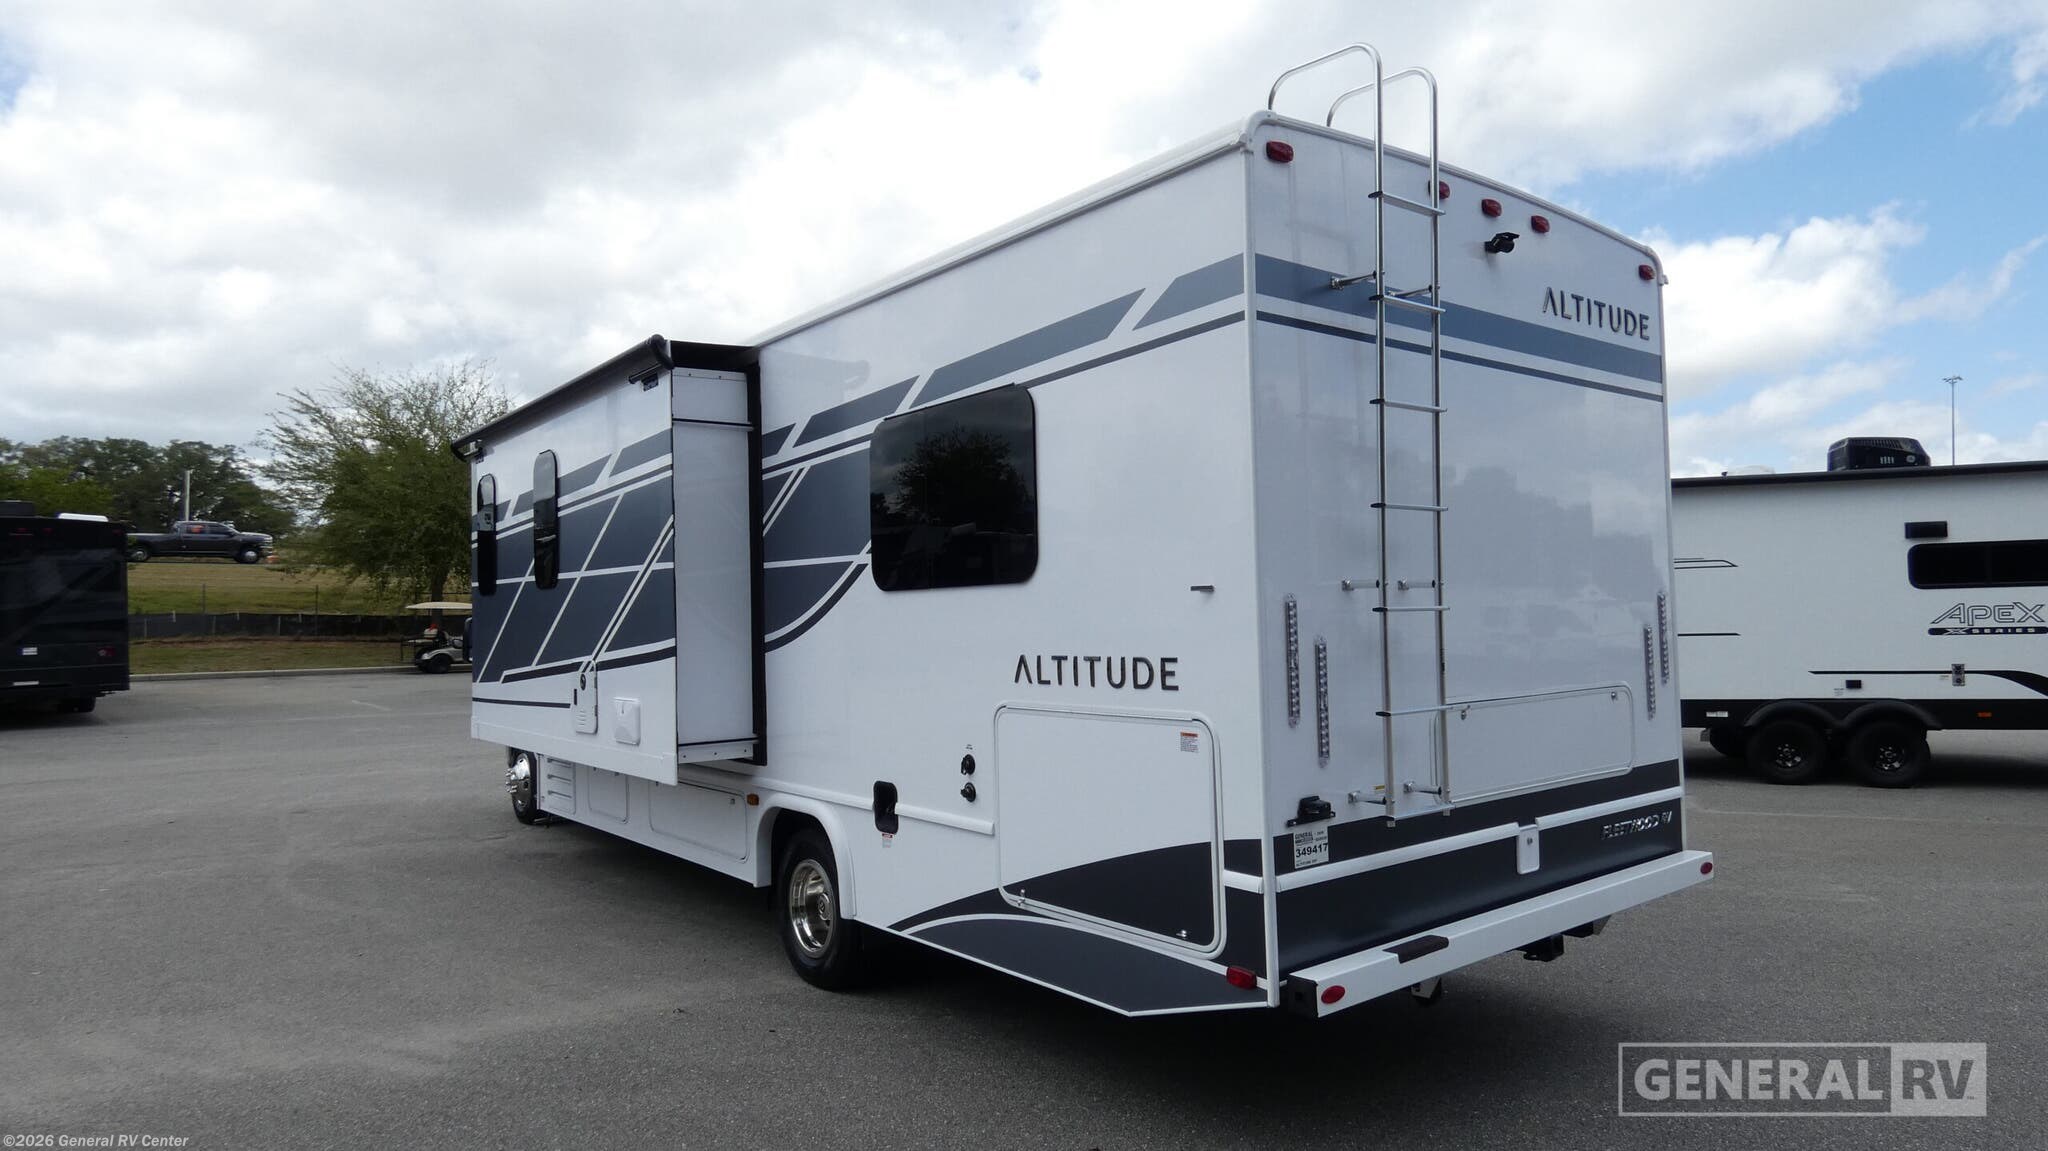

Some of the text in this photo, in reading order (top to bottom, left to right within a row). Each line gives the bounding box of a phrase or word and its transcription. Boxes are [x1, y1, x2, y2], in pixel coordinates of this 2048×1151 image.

[1543, 286, 1650, 341] ALTITUDE
[1930, 602, 2046, 626] APEX
[1971, 627, 2036, 635] SERIES
[1014, 654, 1179, 691] ALTITUDE
[1295, 842, 1329, 858] 349417
